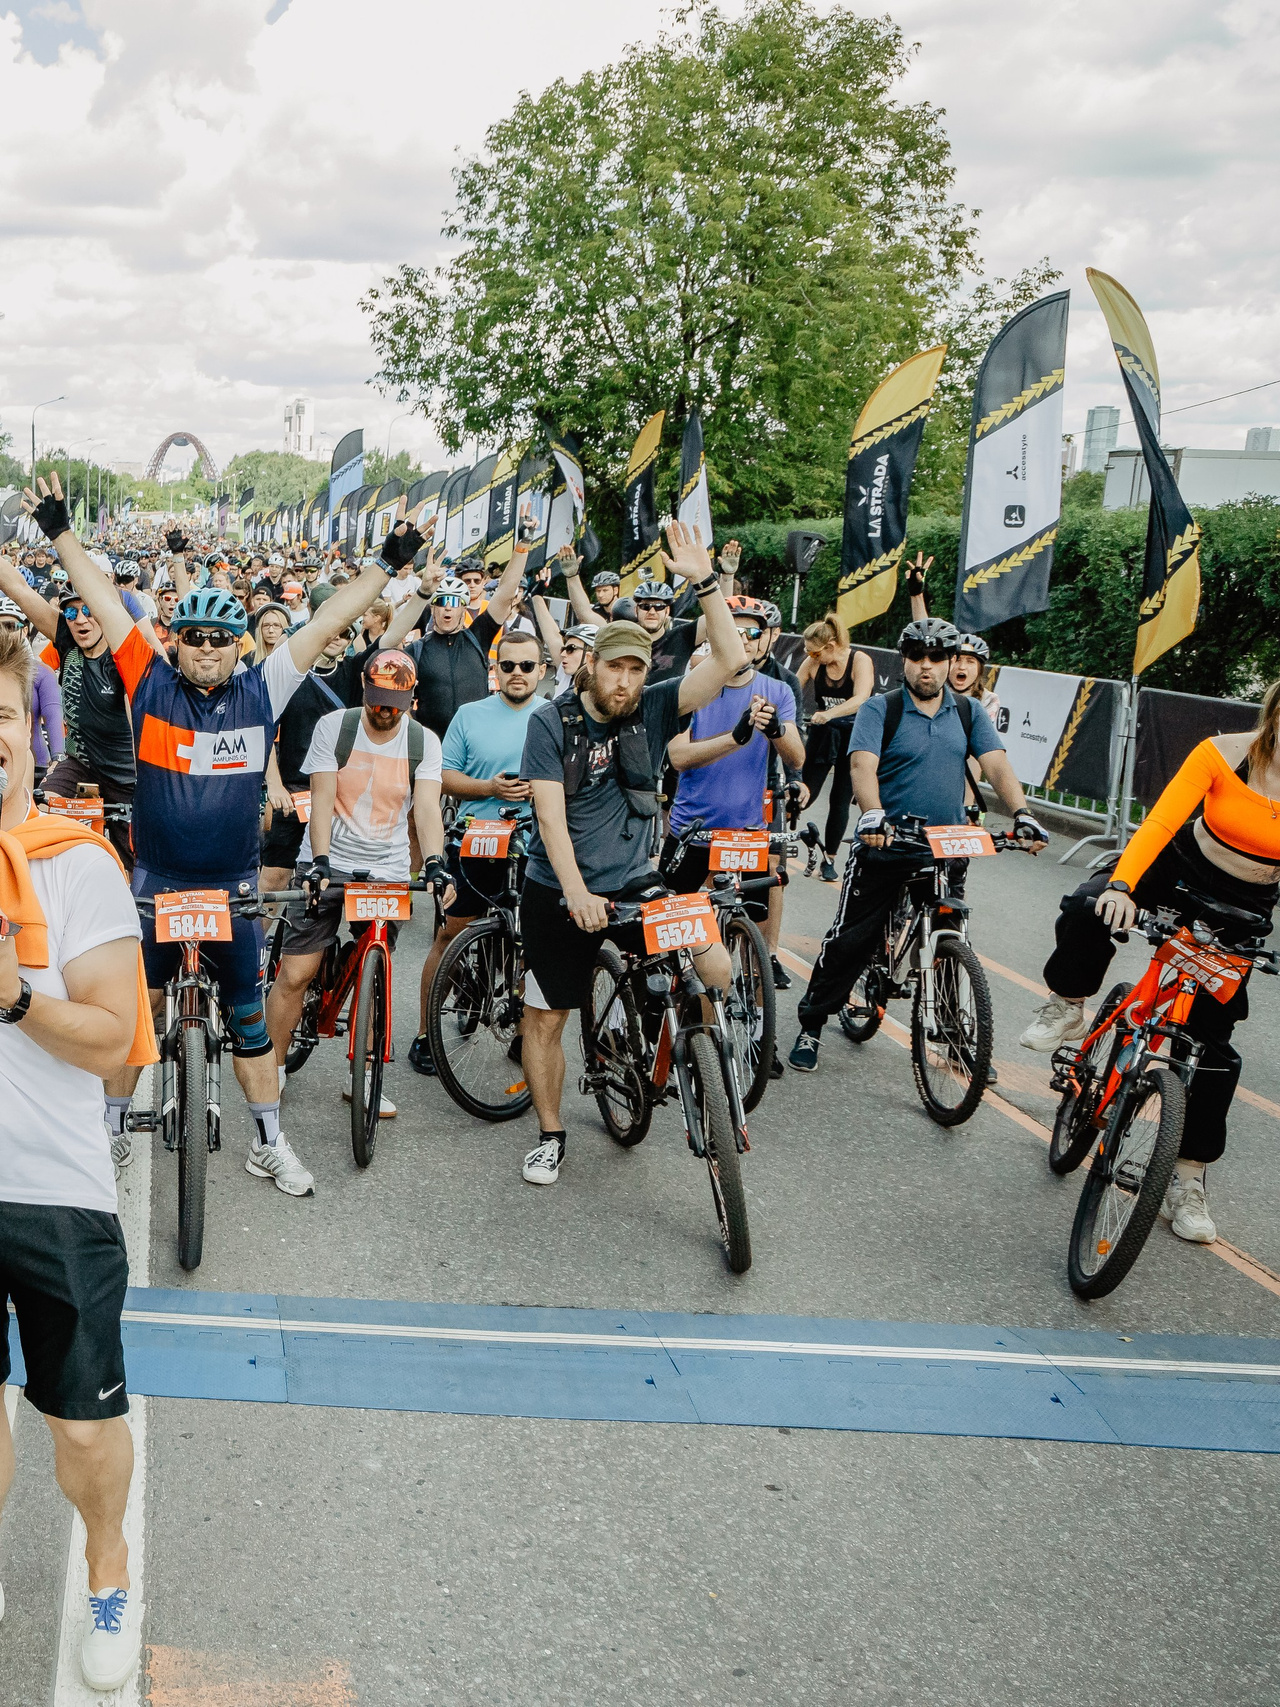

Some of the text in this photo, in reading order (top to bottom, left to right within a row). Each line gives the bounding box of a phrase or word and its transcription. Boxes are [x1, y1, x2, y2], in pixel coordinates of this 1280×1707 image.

[870, 453, 889, 516] STRADA
[502, 484, 513, 525] LA STRADA
[632, 483, 642, 540] LA STRADA
[867, 518, 882, 538] LA
[213, 734, 247, 755] IAM
[470, 836, 499, 856] 6110
[940, 837, 984, 856] 5239
[719, 850, 759, 870] 5545
[356, 897, 400, 918] 5562
[168, 913, 219, 938] 5844
[655, 918, 708, 949] 5524
[1169, 952, 1225, 993] 5053
